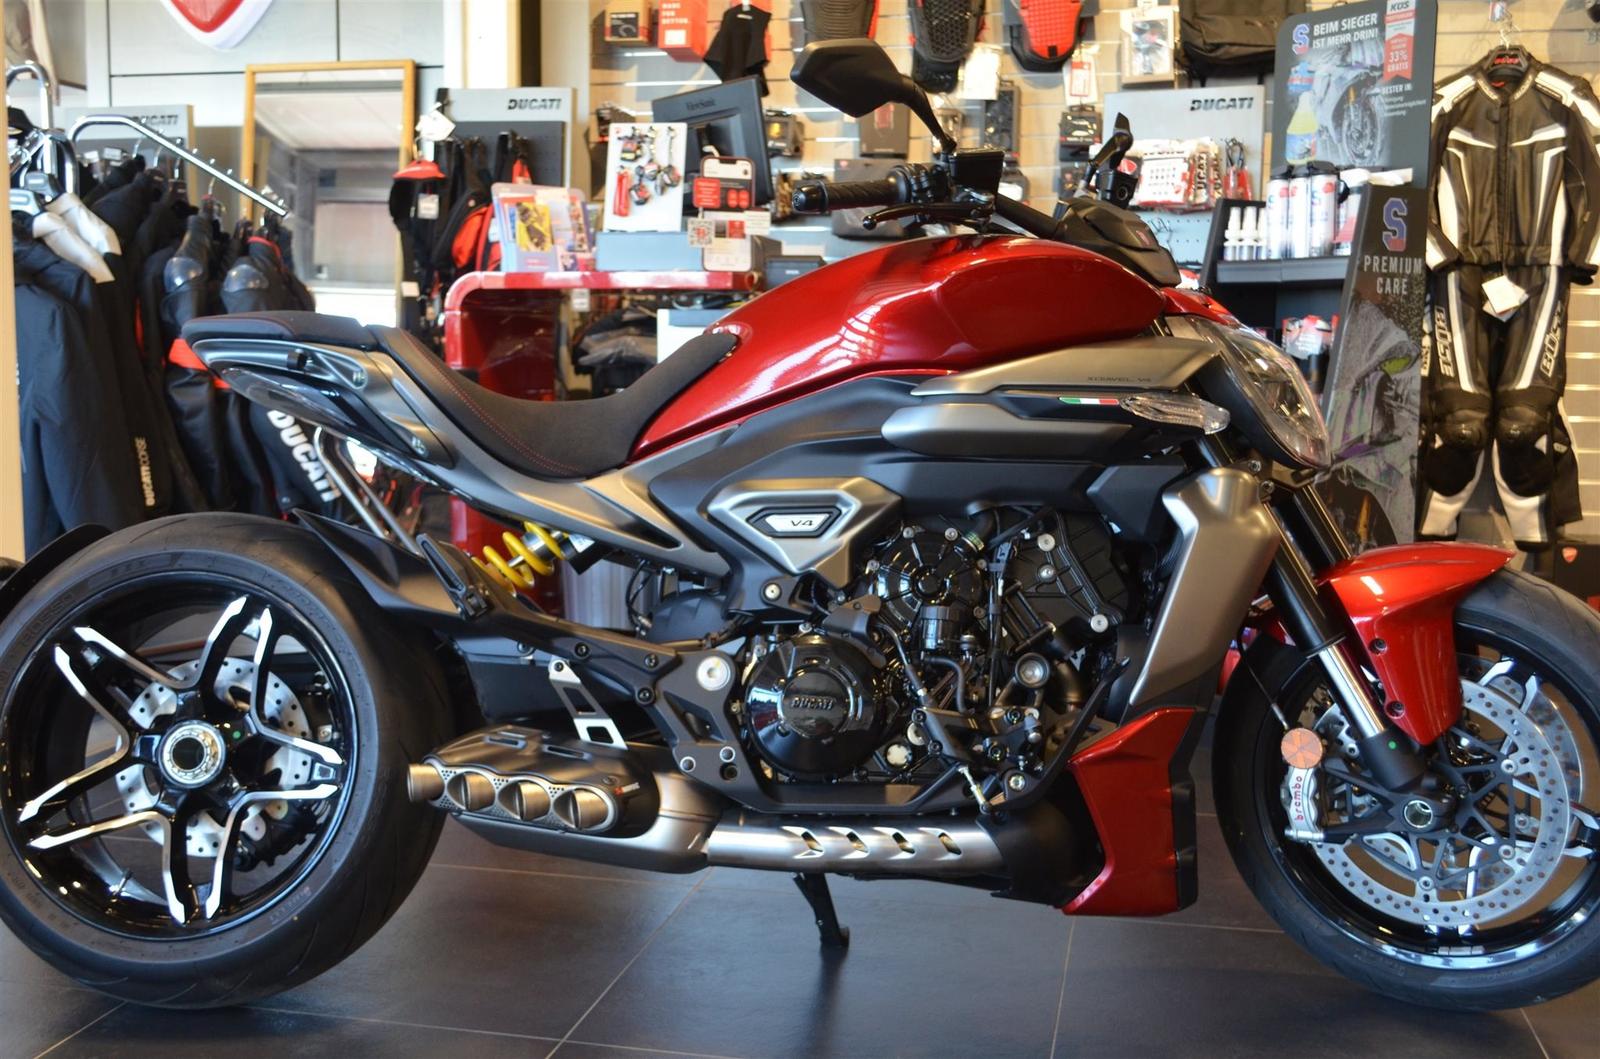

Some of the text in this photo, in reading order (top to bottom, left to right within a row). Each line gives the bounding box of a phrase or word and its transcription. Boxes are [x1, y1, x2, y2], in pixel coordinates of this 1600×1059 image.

[1313, 20, 1339, 36] BEIM
[1341, 13, 1378, 31] SIEGER
[1312, 28, 1379, 49] IST MEHR DRIN!
[507, 98, 562, 111] DUCATI
[1190, 97, 1254, 111] DUCATI
[1363, 255, 1423, 274] PREMIUM
[1376, 277, 1409, 295] CARE
[266, 410, 342, 502] DUCATI
[791, 519, 813, 527] V4
[791, 695, 837, 710] DUCATI
[1291, 775, 1304, 821] brembo
